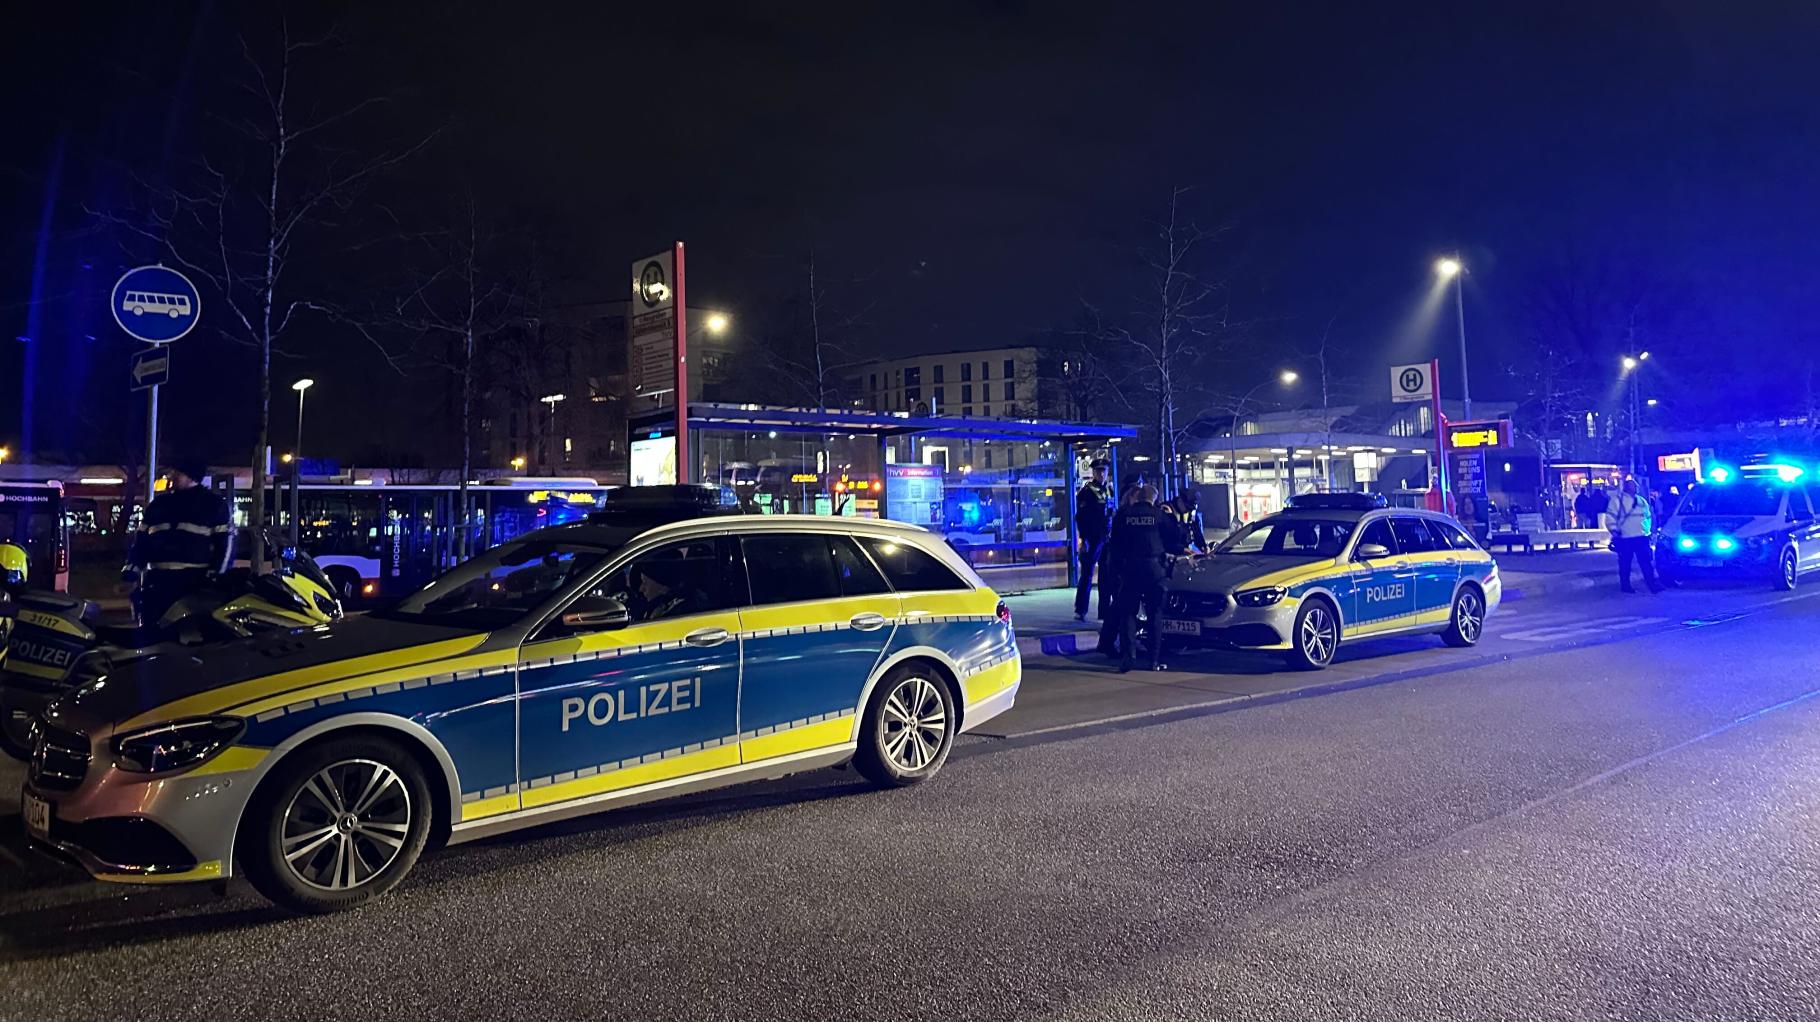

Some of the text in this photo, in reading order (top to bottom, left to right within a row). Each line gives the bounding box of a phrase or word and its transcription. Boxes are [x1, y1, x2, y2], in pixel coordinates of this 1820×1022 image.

[889, 468, 904, 477] hvv
[1126, 516, 1155, 526] POLIZEI
[1366, 583, 1405, 603] POLIZEI
[30, 614, 60, 627] 31/17
[9, 638, 72, 667] POLIZEI
[561, 677, 701, 732] POLIZEI
